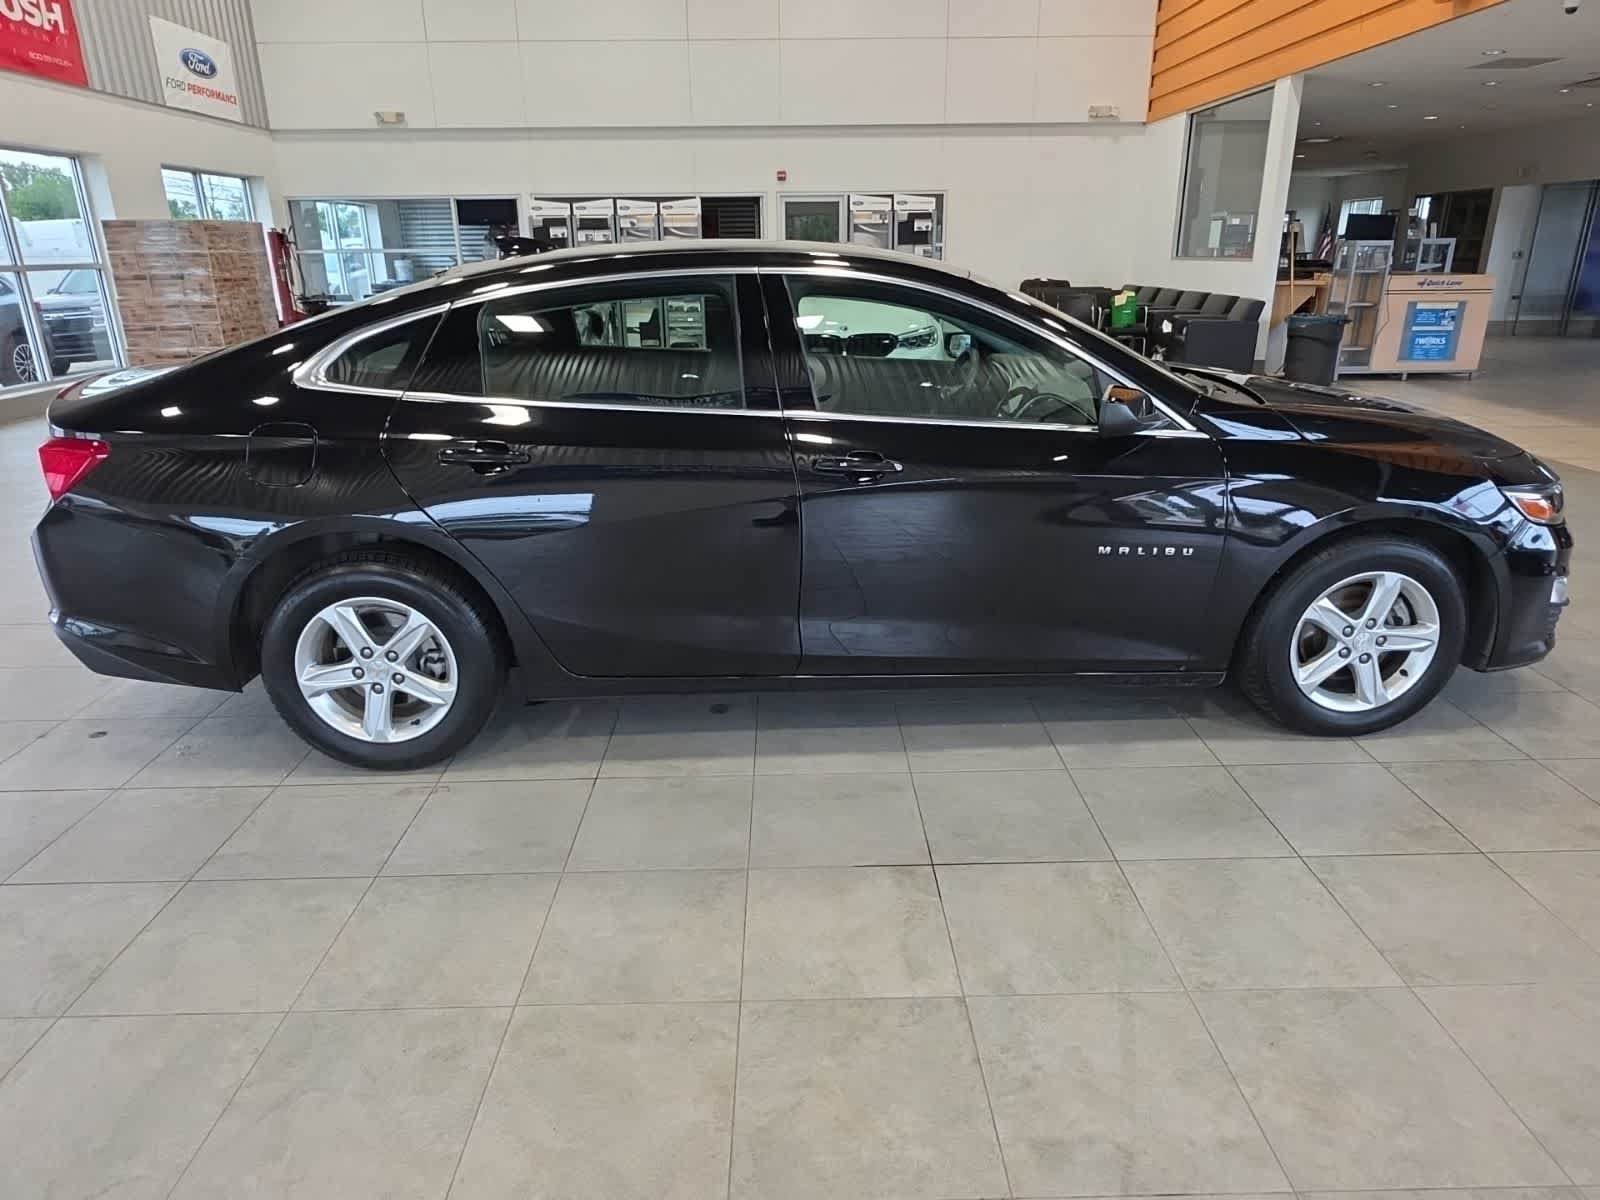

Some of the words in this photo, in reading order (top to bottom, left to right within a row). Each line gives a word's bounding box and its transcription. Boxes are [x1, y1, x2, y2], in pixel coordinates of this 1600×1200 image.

[187, 51, 211, 76] Ford
[166, 76, 186, 91] FORD
[187, 82, 237, 105] PERFORMANCE
[1097, 545, 1194, 556] MALIBU
